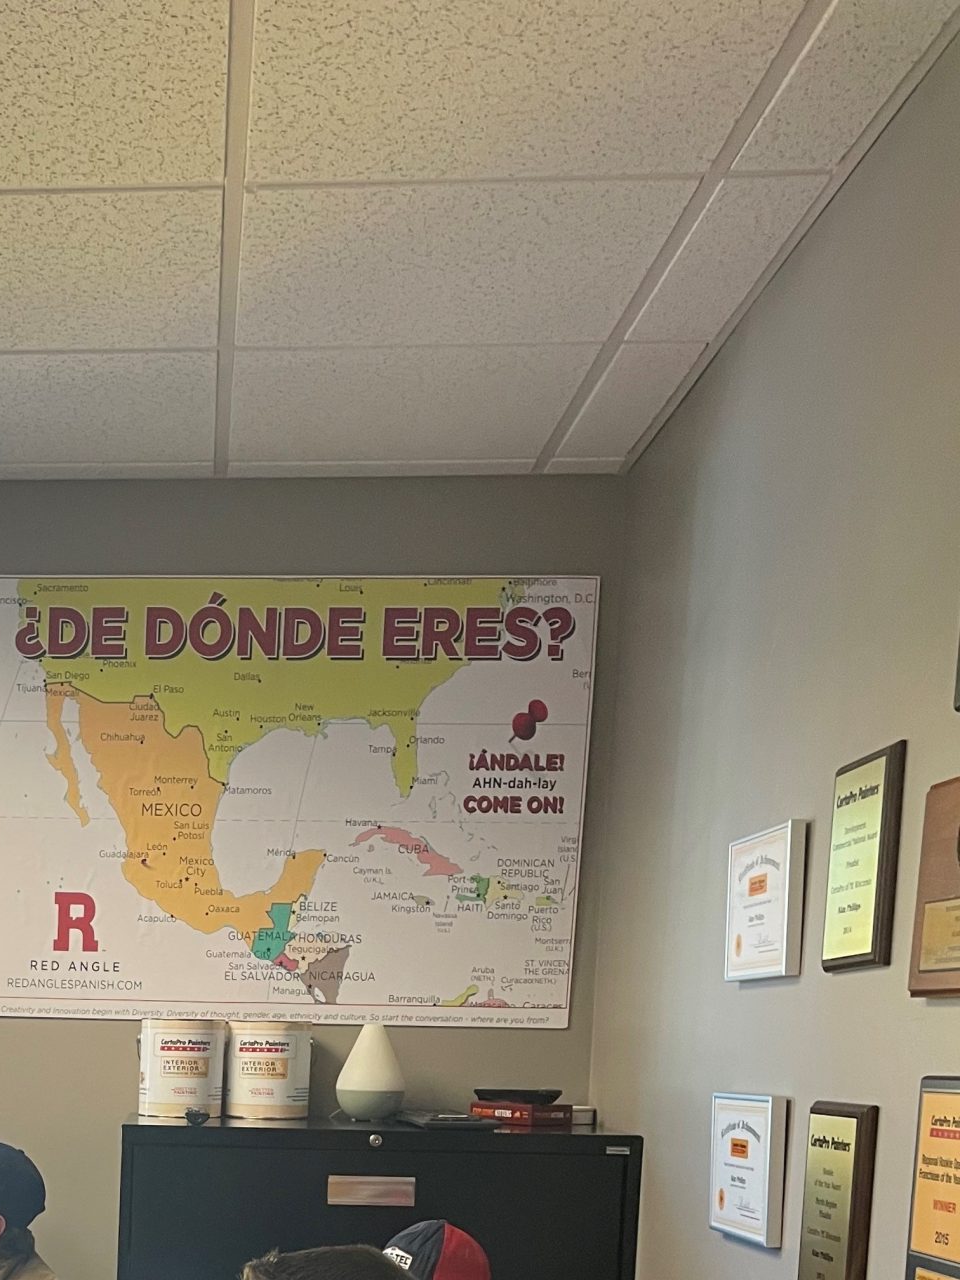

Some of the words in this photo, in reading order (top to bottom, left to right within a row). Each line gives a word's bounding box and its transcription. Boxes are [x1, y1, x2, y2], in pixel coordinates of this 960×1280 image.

[37, 584, 88, 593] Sacramento
[15, 606, 128, 660] ¿DE
[145, 591, 365, 661] DÓNDE
[382, 606, 576, 661] ERES?
[103, 660, 136, 669] Phoenix
[46, 671, 63, 679] San
[65, 671, 90, 681] Diego
[234, 672, 261, 681] Dallas
[153, 685, 162, 693] El
[164, 685, 184, 693] Paso
[129, 703, 159, 711] Ciudad
[295, 703, 314, 711] New
[213, 708, 240, 717] Austin
[288, 713, 322, 721] Orleans
[367, 709, 420, 717] Jacksonville
[130, 713, 159, 722] Juarez
[250, 714, 286, 723] Houston
[100, 733, 145, 742] Chihuahua
[217, 734, 232, 742] San
[409, 735, 445, 744] Orlando
[208, 744, 243, 752] Antonio
[368, 745, 398, 754] Tampa
[154, 776, 198, 786] Monterrey
[412, 777, 438, 785] Miami
[473, 778, 556, 791] AHN-dah-lay
[224, 786, 272, 795] Matamoros
[463, 796, 522, 814] COME
[527, 796, 565, 814] ON!
[142, 803, 202, 817] MEXICO
[174, 821, 190, 829] San
[192, 821, 209, 829] Luis
[345, 818, 378, 827] Havana
[398, 844, 429, 854] CUBA
[99, 850, 149, 860] Guadalajara
[179, 857, 214, 866] Mexico
[497, 859, 555, 868] DOMINICAN
[186, 866, 207, 877] City
[501, 869, 549, 878] REPUBLIC
[156, 880, 183, 889] Toluca
[544, 878, 560, 886] San
[194, 887, 223, 896] Puebla
[500, 883, 539, 893] Santiago
[542, 887, 562, 895] Juan
[371, 892, 414, 901] JAMAICA
[208, 904, 240, 913] Oaxaca
[300, 902, 337, 912] BELIZE
[392, 904, 431, 914] Kingston
[457, 904, 483, 912] HAITI
[495, 901, 521, 910] Santo
[528, 905, 559, 914] Puerto
[137, 914, 177, 924] Acapulco
[296, 914, 339, 923] Belmopan
[487, 912, 528, 921] Domingo
[532, 916, 552, 924] Rico
[228, 931, 296, 941] GUATEMALA
[298, 933, 362, 944] HONDURAS
[205, 950, 251, 959] Guatemala
[254, 950, 272, 960] City
[30, 960, 60, 971] RED
[68, 961, 121, 973] ANGLE
[228, 962, 245, 970] San
[472, 966, 495, 974] Aruba
[224, 971, 238, 981] EL
[240, 971, 300, 982] SALVADOR
[309, 972, 376, 982] NICARAGUA
[7, 977, 143, 992] REDANGLESPANISH.COM
[388, 995, 441, 1004] Barranquilla
[1, 1005, 36, 1015] Creativity
[37, 1006, 51, 1014] and
[92, 1007, 113, 1016] begin
[114, 1007, 131, 1016] with
[166, 1009, 199, 1018] Diversity
[200, 1009, 209, 1017] of
[290, 1011, 321, 1021] ethnicity
[323, 1012, 339, 1020] and
[369, 1013, 380, 1021] So
[381, 1014, 400, 1022] start
[401, 1014, 414, 1022] the
[415, 1014, 464, 1023] conversation
[470, 1015, 494, 1023] where
[495, 1016, 508, 1024] are
[509, 1016, 525, 1025] you
[526, 1015, 550, 1025] from?
[161, 1039, 187, 1047] CertaPro
[187, 1038, 211, 1047] Painters
[239, 1039, 264, 1047] CertaPro
[265, 1039, 290, 1047] Painters
[933, 1199, 957, 1215] WINNER
[934, 1231, 950, 1246] 2015
